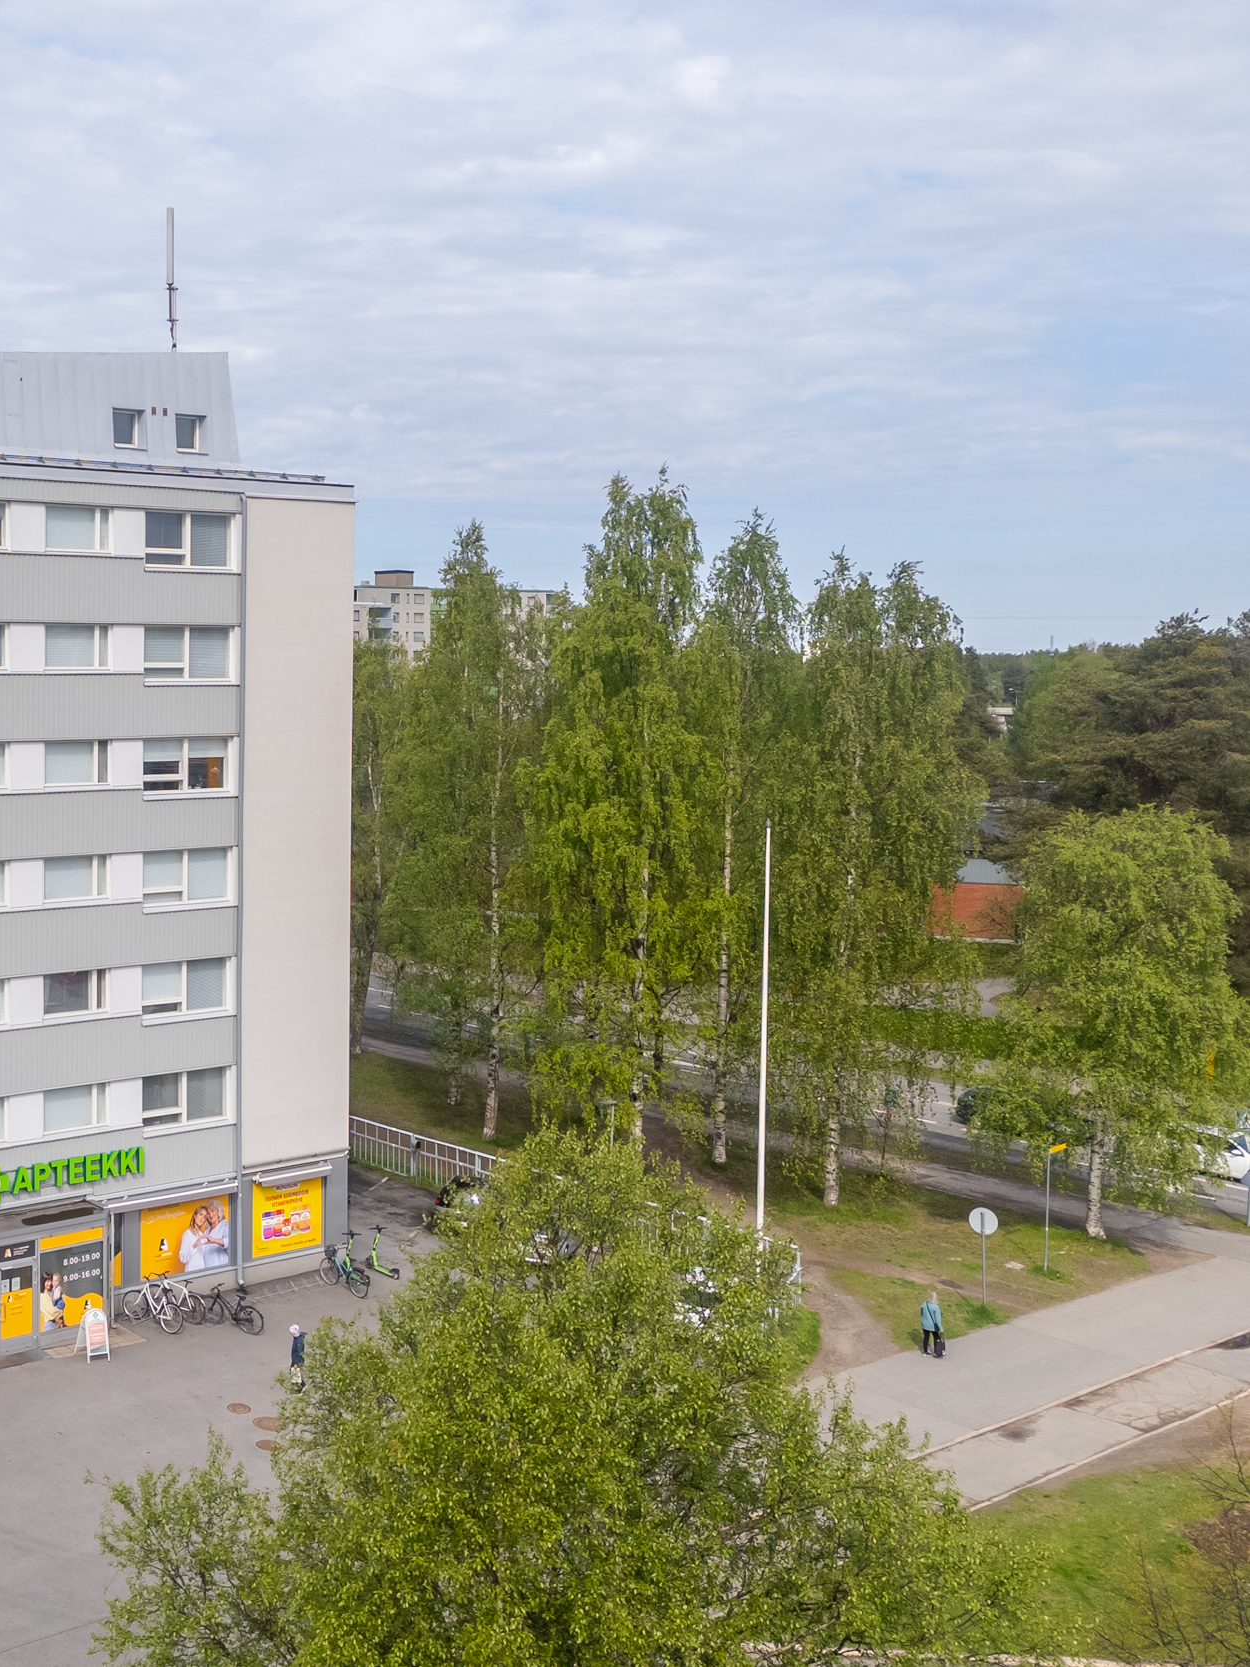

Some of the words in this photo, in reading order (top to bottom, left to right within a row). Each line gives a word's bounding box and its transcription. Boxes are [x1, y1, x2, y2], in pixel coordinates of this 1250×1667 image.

[12, 1146, 145, 1194] APTEEKKI
[63, 1252, 101, 1266] 8.00-19.00
[63, 1268, 101, 1283] 9.00-16.00
